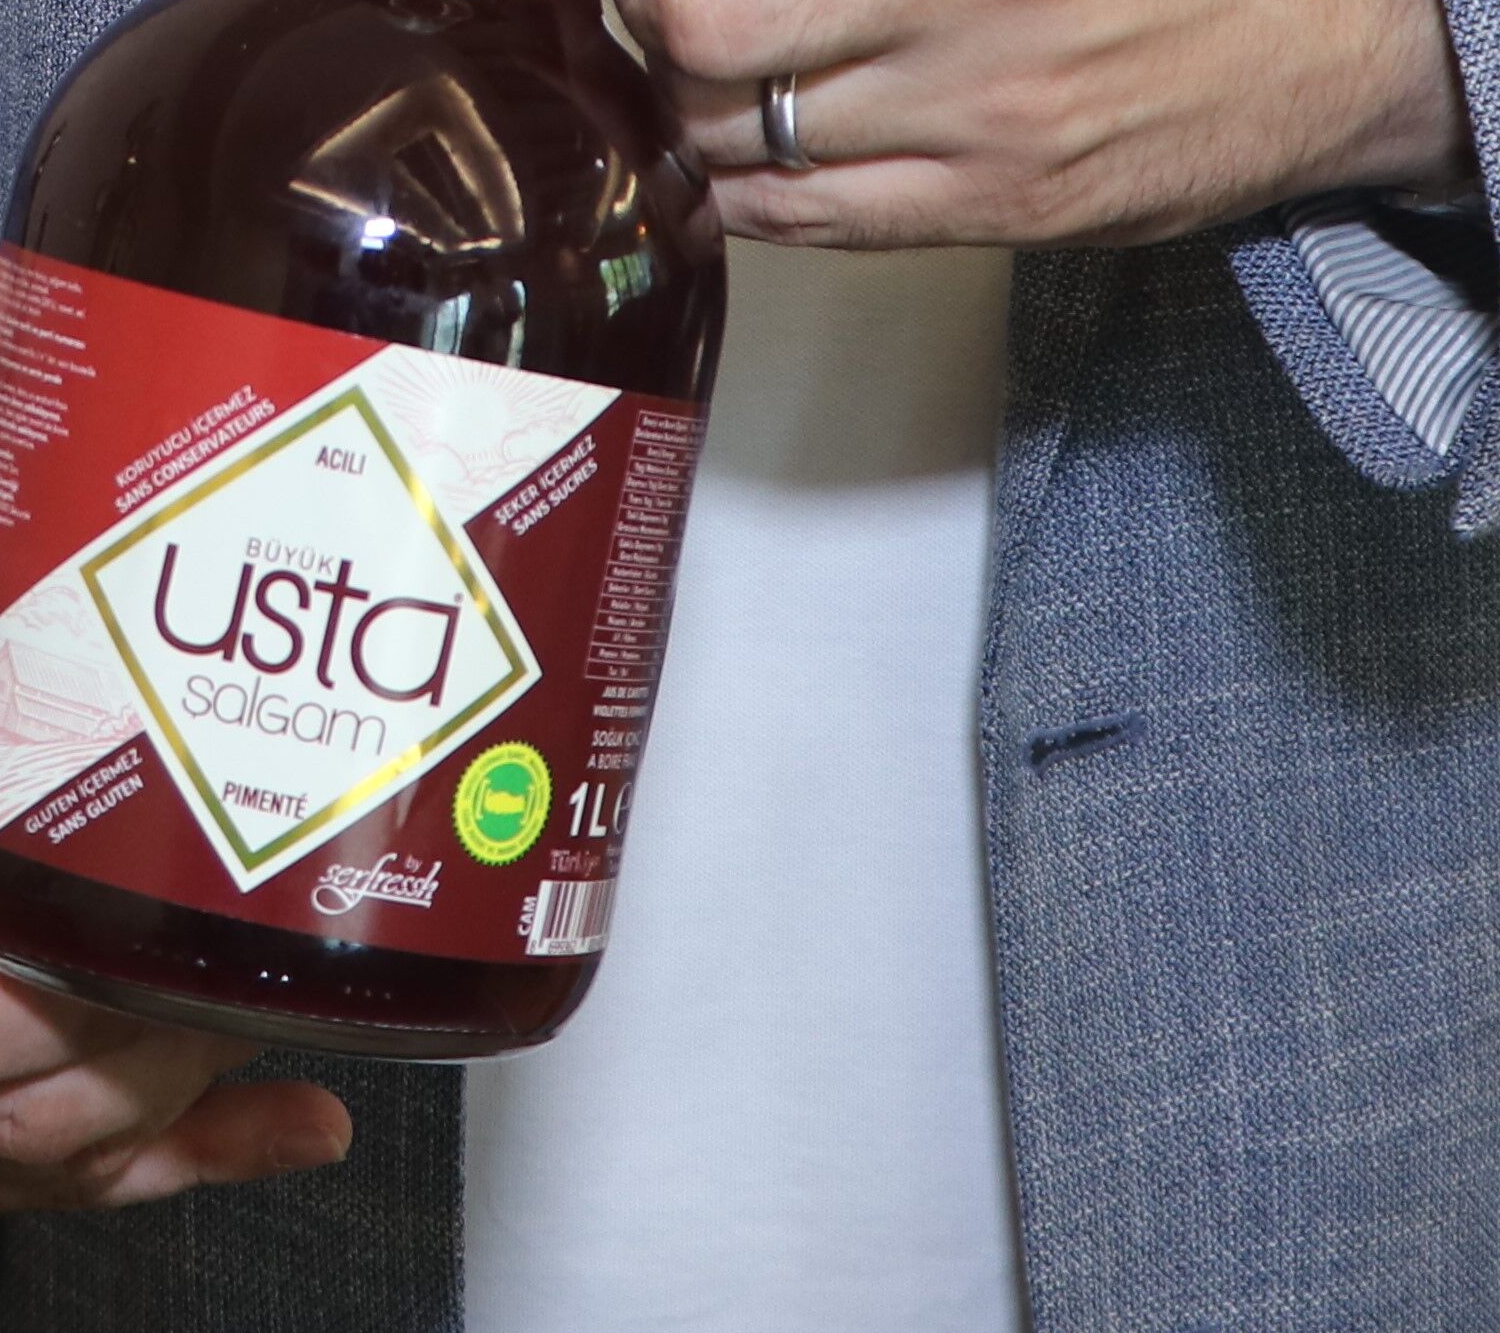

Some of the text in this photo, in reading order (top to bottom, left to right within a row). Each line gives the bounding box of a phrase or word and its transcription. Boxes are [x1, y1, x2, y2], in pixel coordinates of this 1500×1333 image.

[114, 397, 277, 514] SANS CONSERVATEURS
[115, 426, 192, 489] KORUYUCU
[314, 445, 367, 475] ACILI
[511, 498, 551, 536] SANS
[547, 456, 599, 507] SUCRES
[245, 537, 334, 576] BÜYÜK
[154, 542, 462, 708] usta
[24, 788, 79, 834] GLUTEN
[47, 773, 145, 845] SANS GLUTEN
[221, 780, 309, 820] PIMENTÉ
